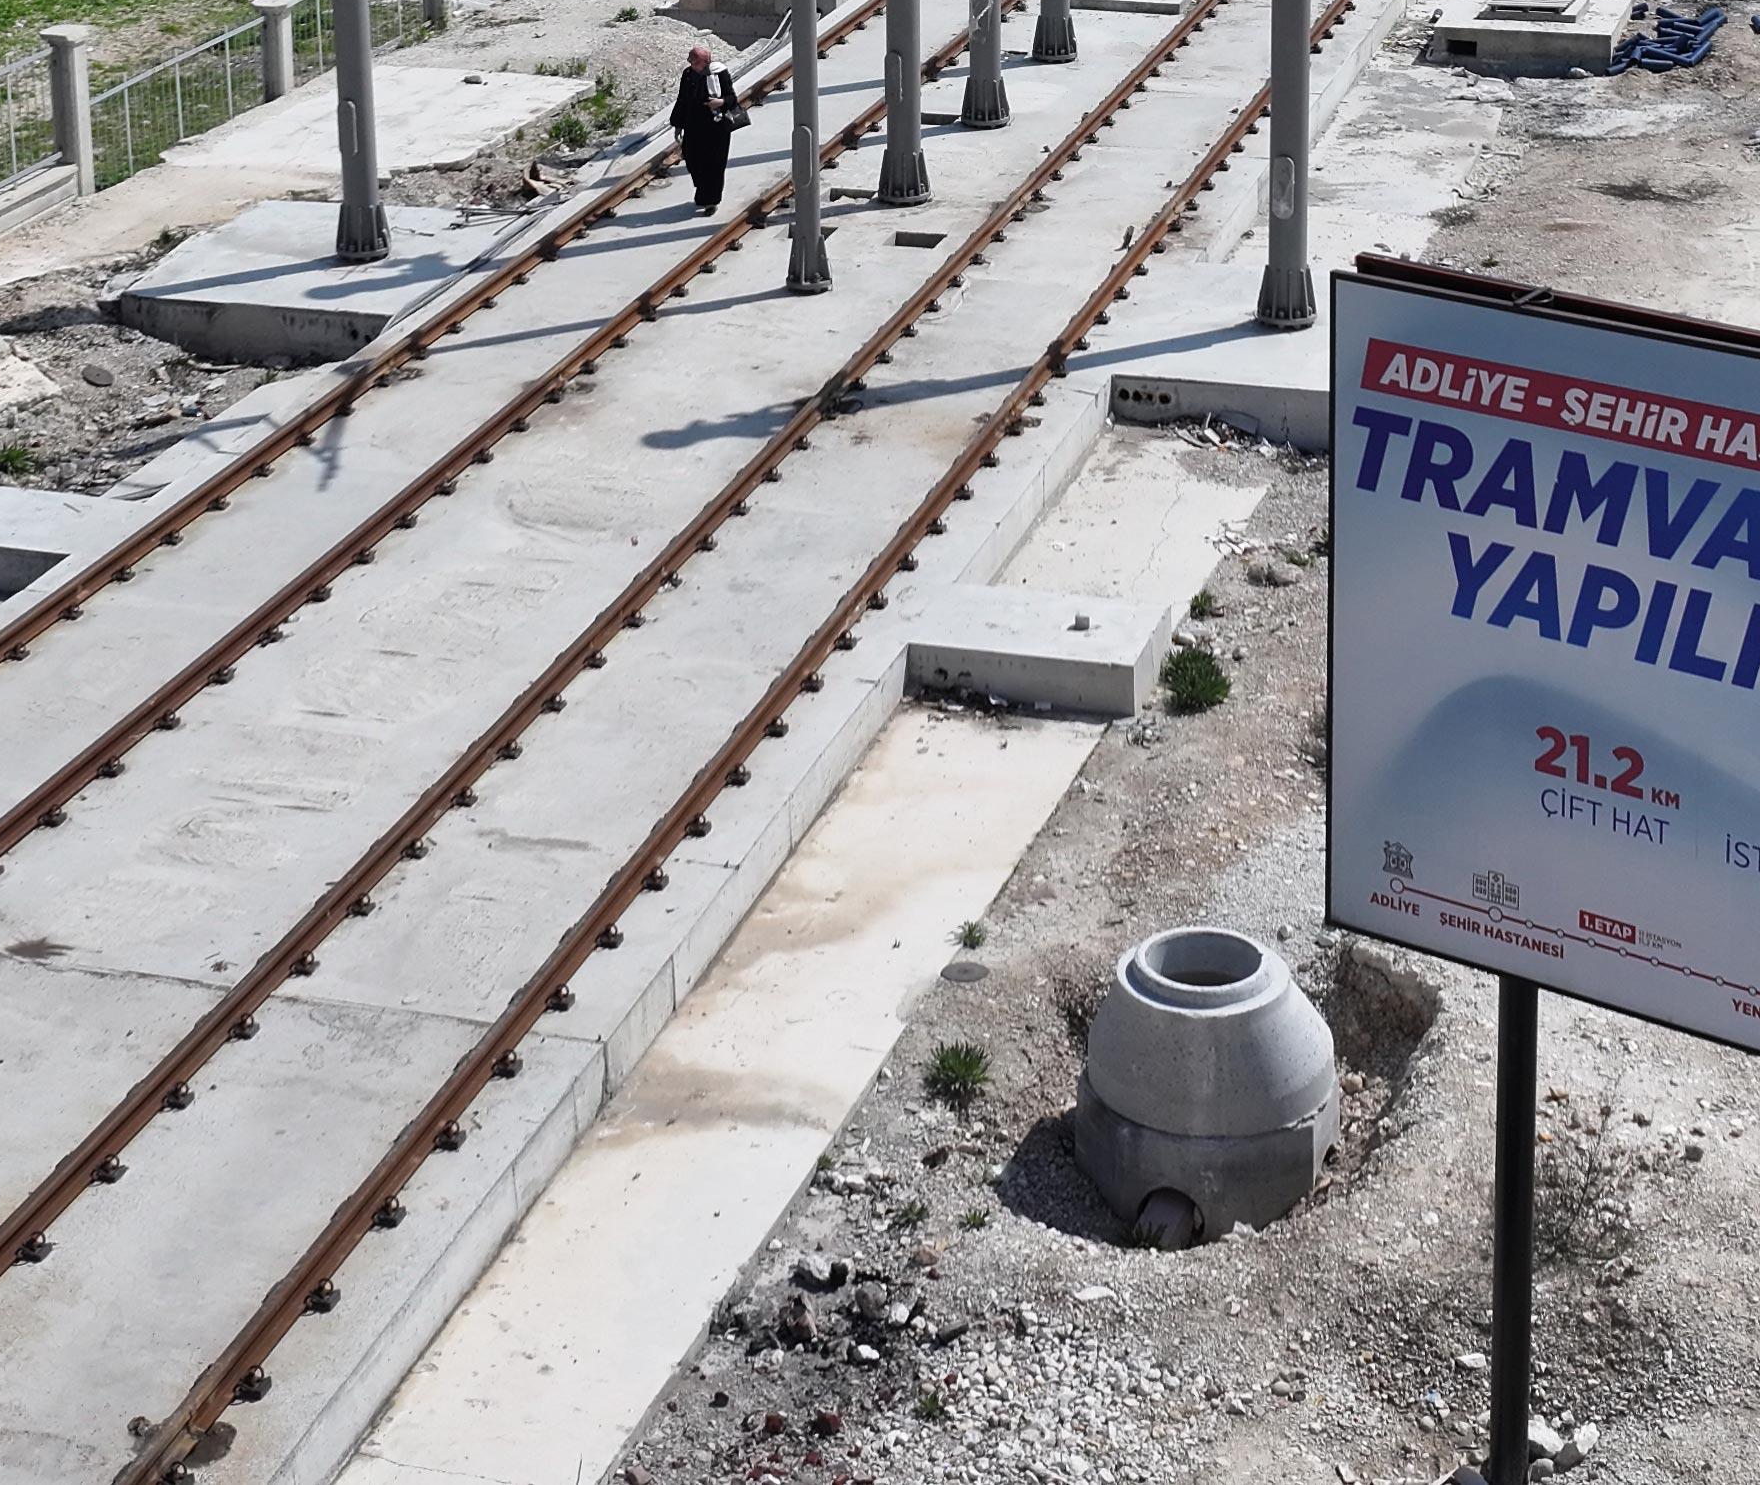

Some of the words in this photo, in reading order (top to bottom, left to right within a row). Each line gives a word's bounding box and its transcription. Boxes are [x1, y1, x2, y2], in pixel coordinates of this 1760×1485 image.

[1380, 353, 1529, 412] ADLİYE
[1536, 395, 1552, 408] -
[1560, 388, 1689, 446] ŞEHİR
[1535, 726, 1644, 800] 21.2
[1651, 787, 1680, 810] KM
[1540, 787, 1603, 827] ÇİFT
[1612, 806, 1670, 845] HAT
[1370, 892, 1421, 917] ADLİYE
[1583, 915, 1632, 939] 1.ETAP
[1440, 912, 1481, 935] ŞEHİR
[1484, 923, 1565, 959] HASTANESİ
